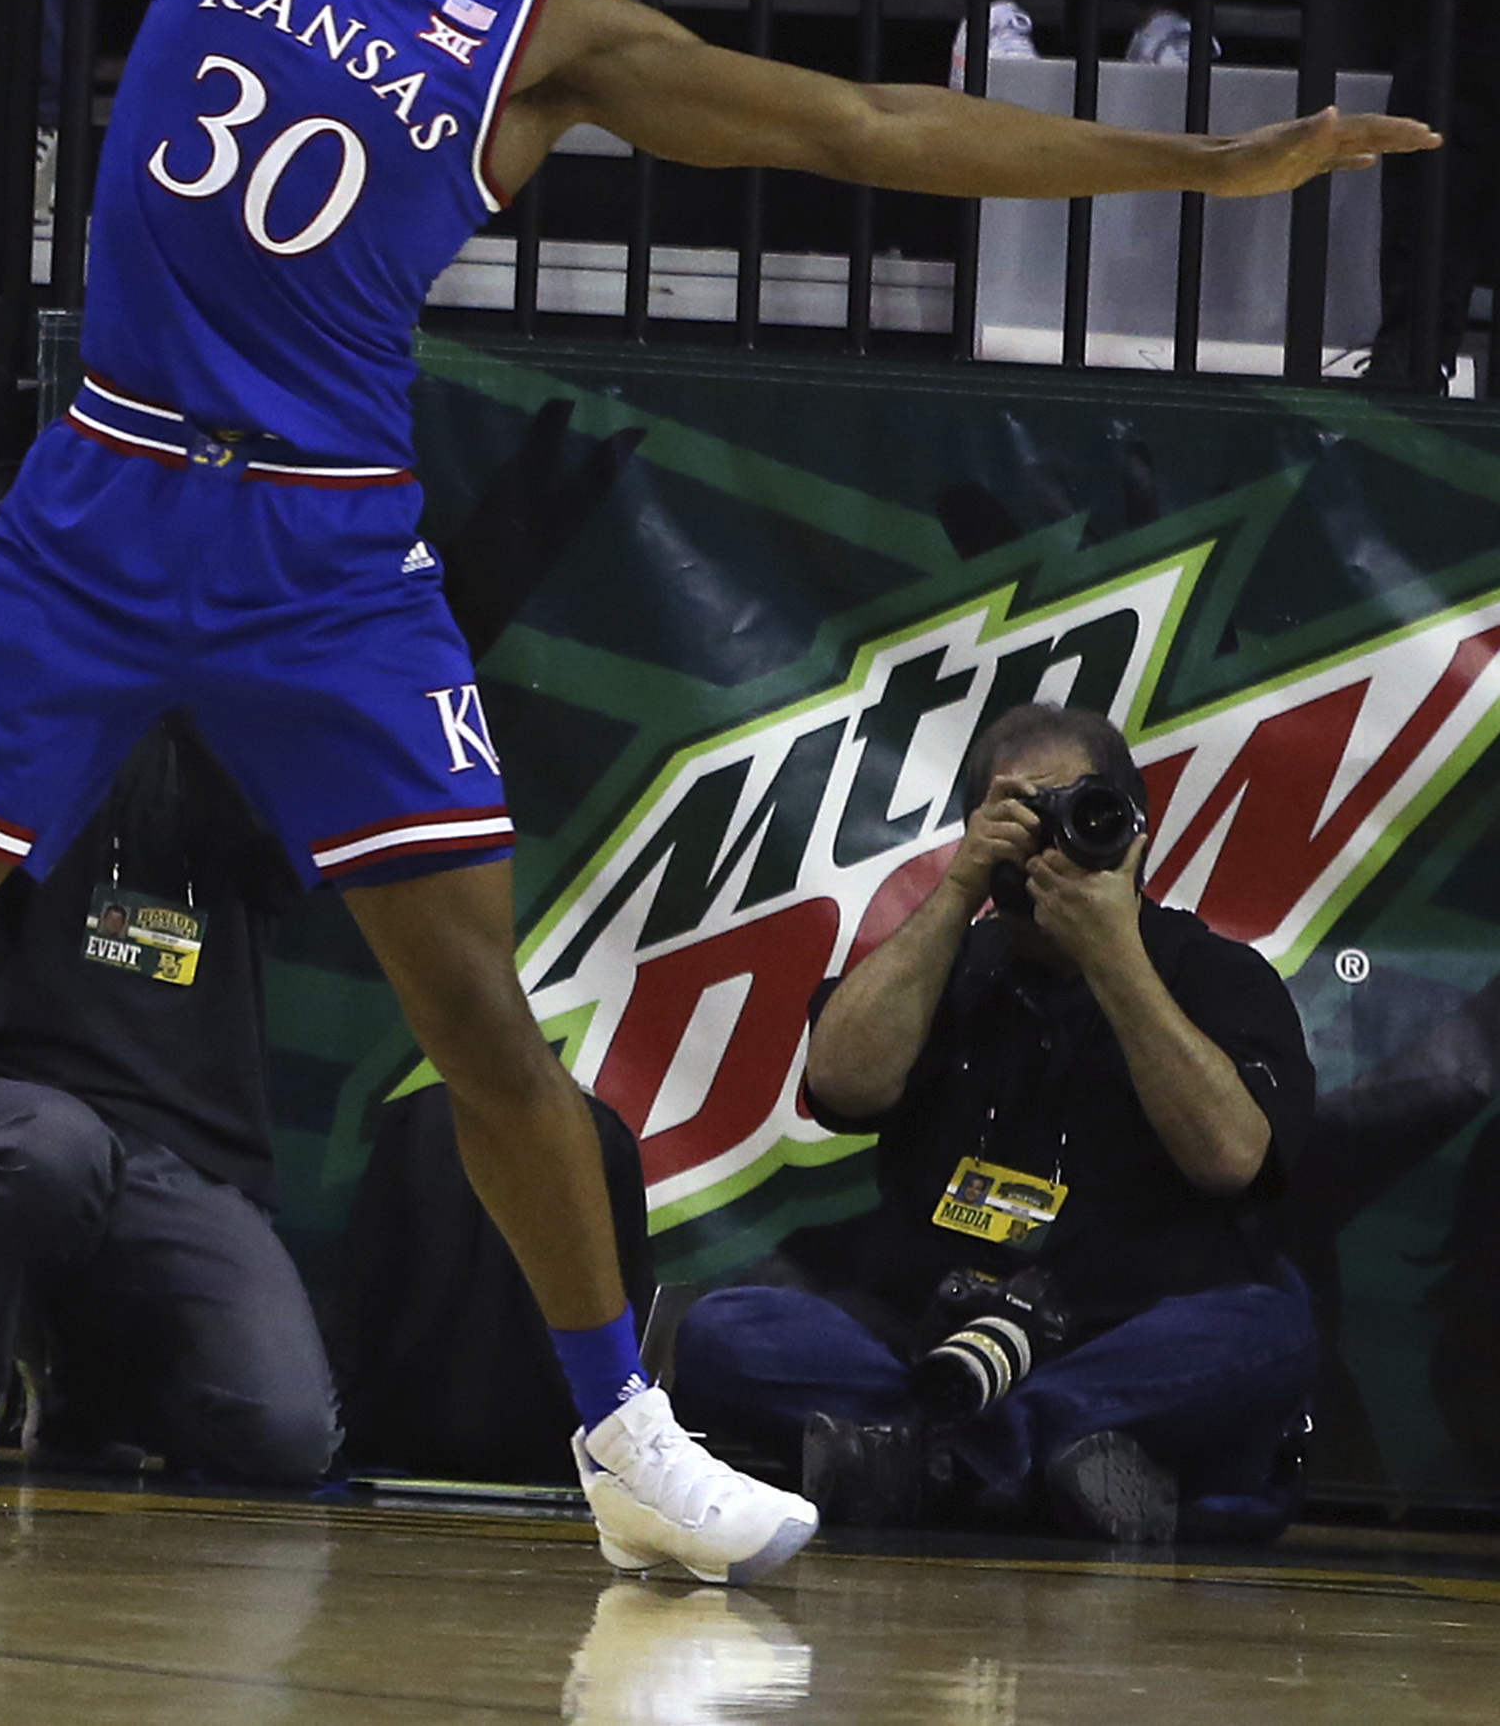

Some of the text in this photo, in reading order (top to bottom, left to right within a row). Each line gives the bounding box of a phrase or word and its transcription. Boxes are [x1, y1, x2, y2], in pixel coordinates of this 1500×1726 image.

[147, 53, 368, 256] 30
[86, 935, 141, 966] EVENT
[595, 624, 1500, 1186] DW
[940, 1201, 994, 1231] MEDIA
